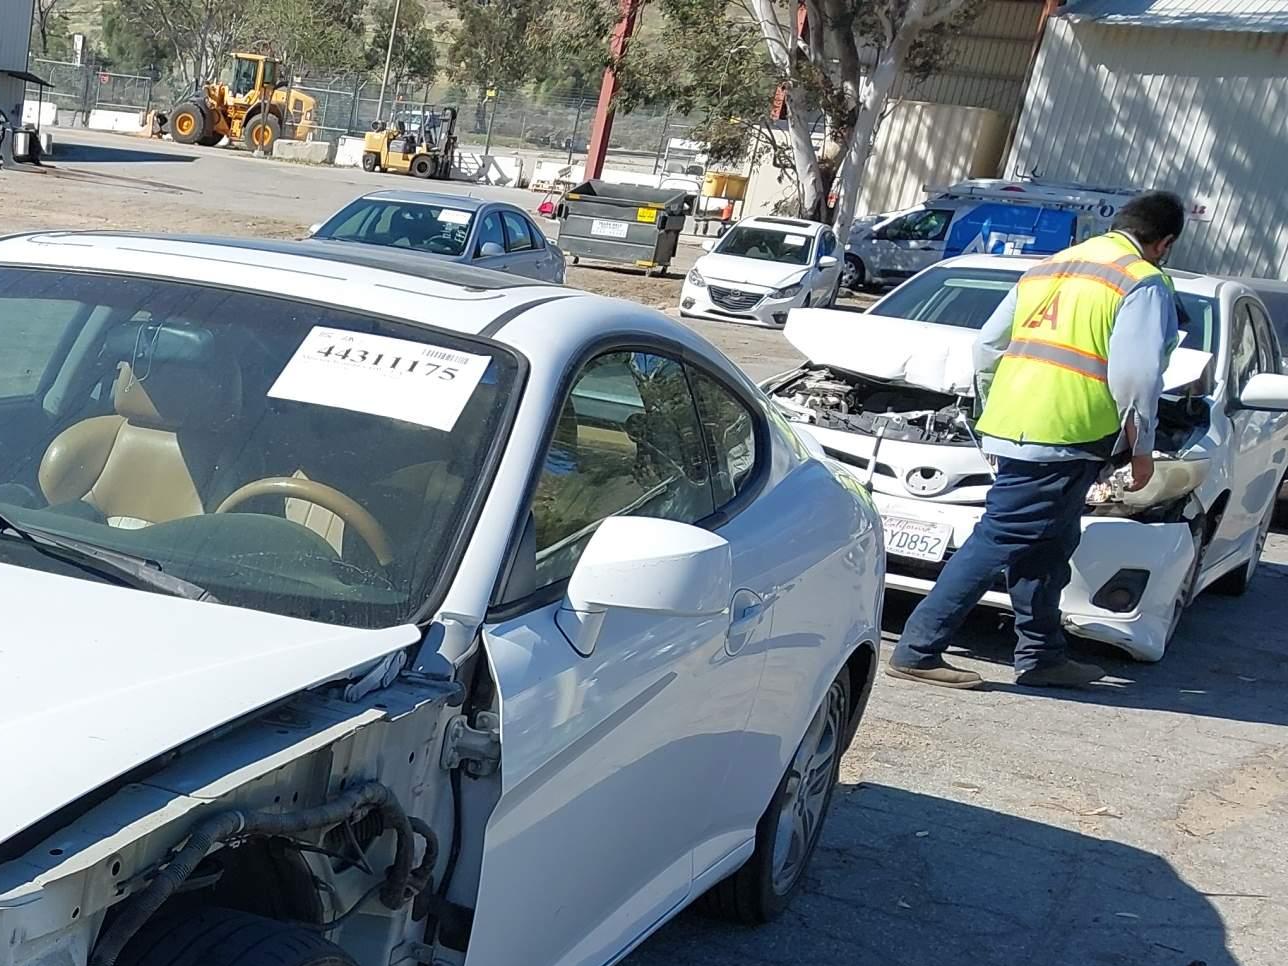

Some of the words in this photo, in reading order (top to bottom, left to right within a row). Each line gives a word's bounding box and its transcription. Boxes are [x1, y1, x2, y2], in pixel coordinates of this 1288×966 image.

[961, 230, 1037, 256] ADT
[316, 344, 460, 382] 44311175
[884, 528, 942, 555] YD852
